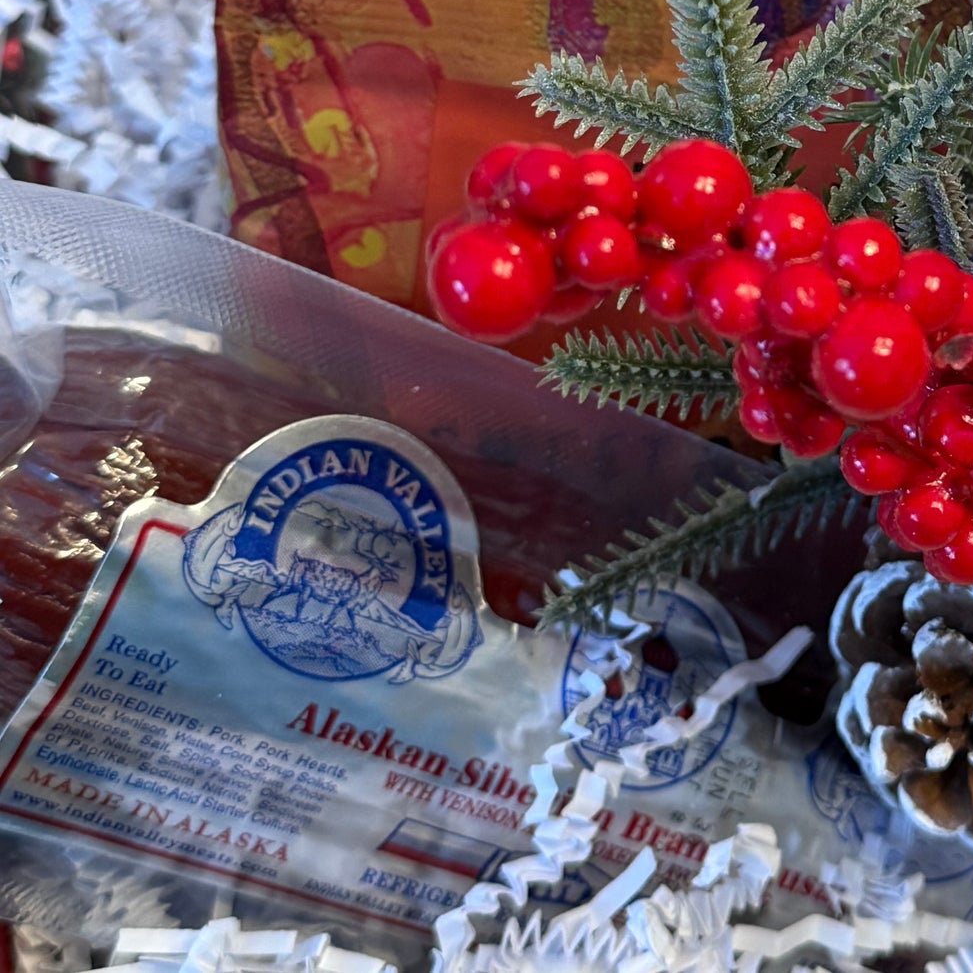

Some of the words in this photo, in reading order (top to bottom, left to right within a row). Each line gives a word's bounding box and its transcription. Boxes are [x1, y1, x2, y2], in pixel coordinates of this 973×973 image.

[246, 447, 373, 535] INDIAN
[384, 457, 449, 600] VALLEY
[95, 658, 124, 680] To
[127, 670, 169, 695] Eat
[105, 633, 180, 675] Ready
[79, 682, 203, 732] INGREDIENTS:
[254, 740, 294, 761] Pork
[35, 744, 120, 784] Erythorbate,
[124, 771, 167, 795] Lactic
[166, 786, 200, 805] Acid
[137, 761, 196, 787] Sodium
[219, 745, 253, 763] Corn
[254, 757, 295, 781] Syrup
[25, 768, 125, 811] MADE
[129, 798, 172, 826] IN
[174, 814, 289, 864] ALASKA
[385, 770, 438, 803] WITH
[438, 789, 523, 830] VENISON
[620, 809, 711, 865] Bran
[359, 866, 465, 909] REFRIGE
